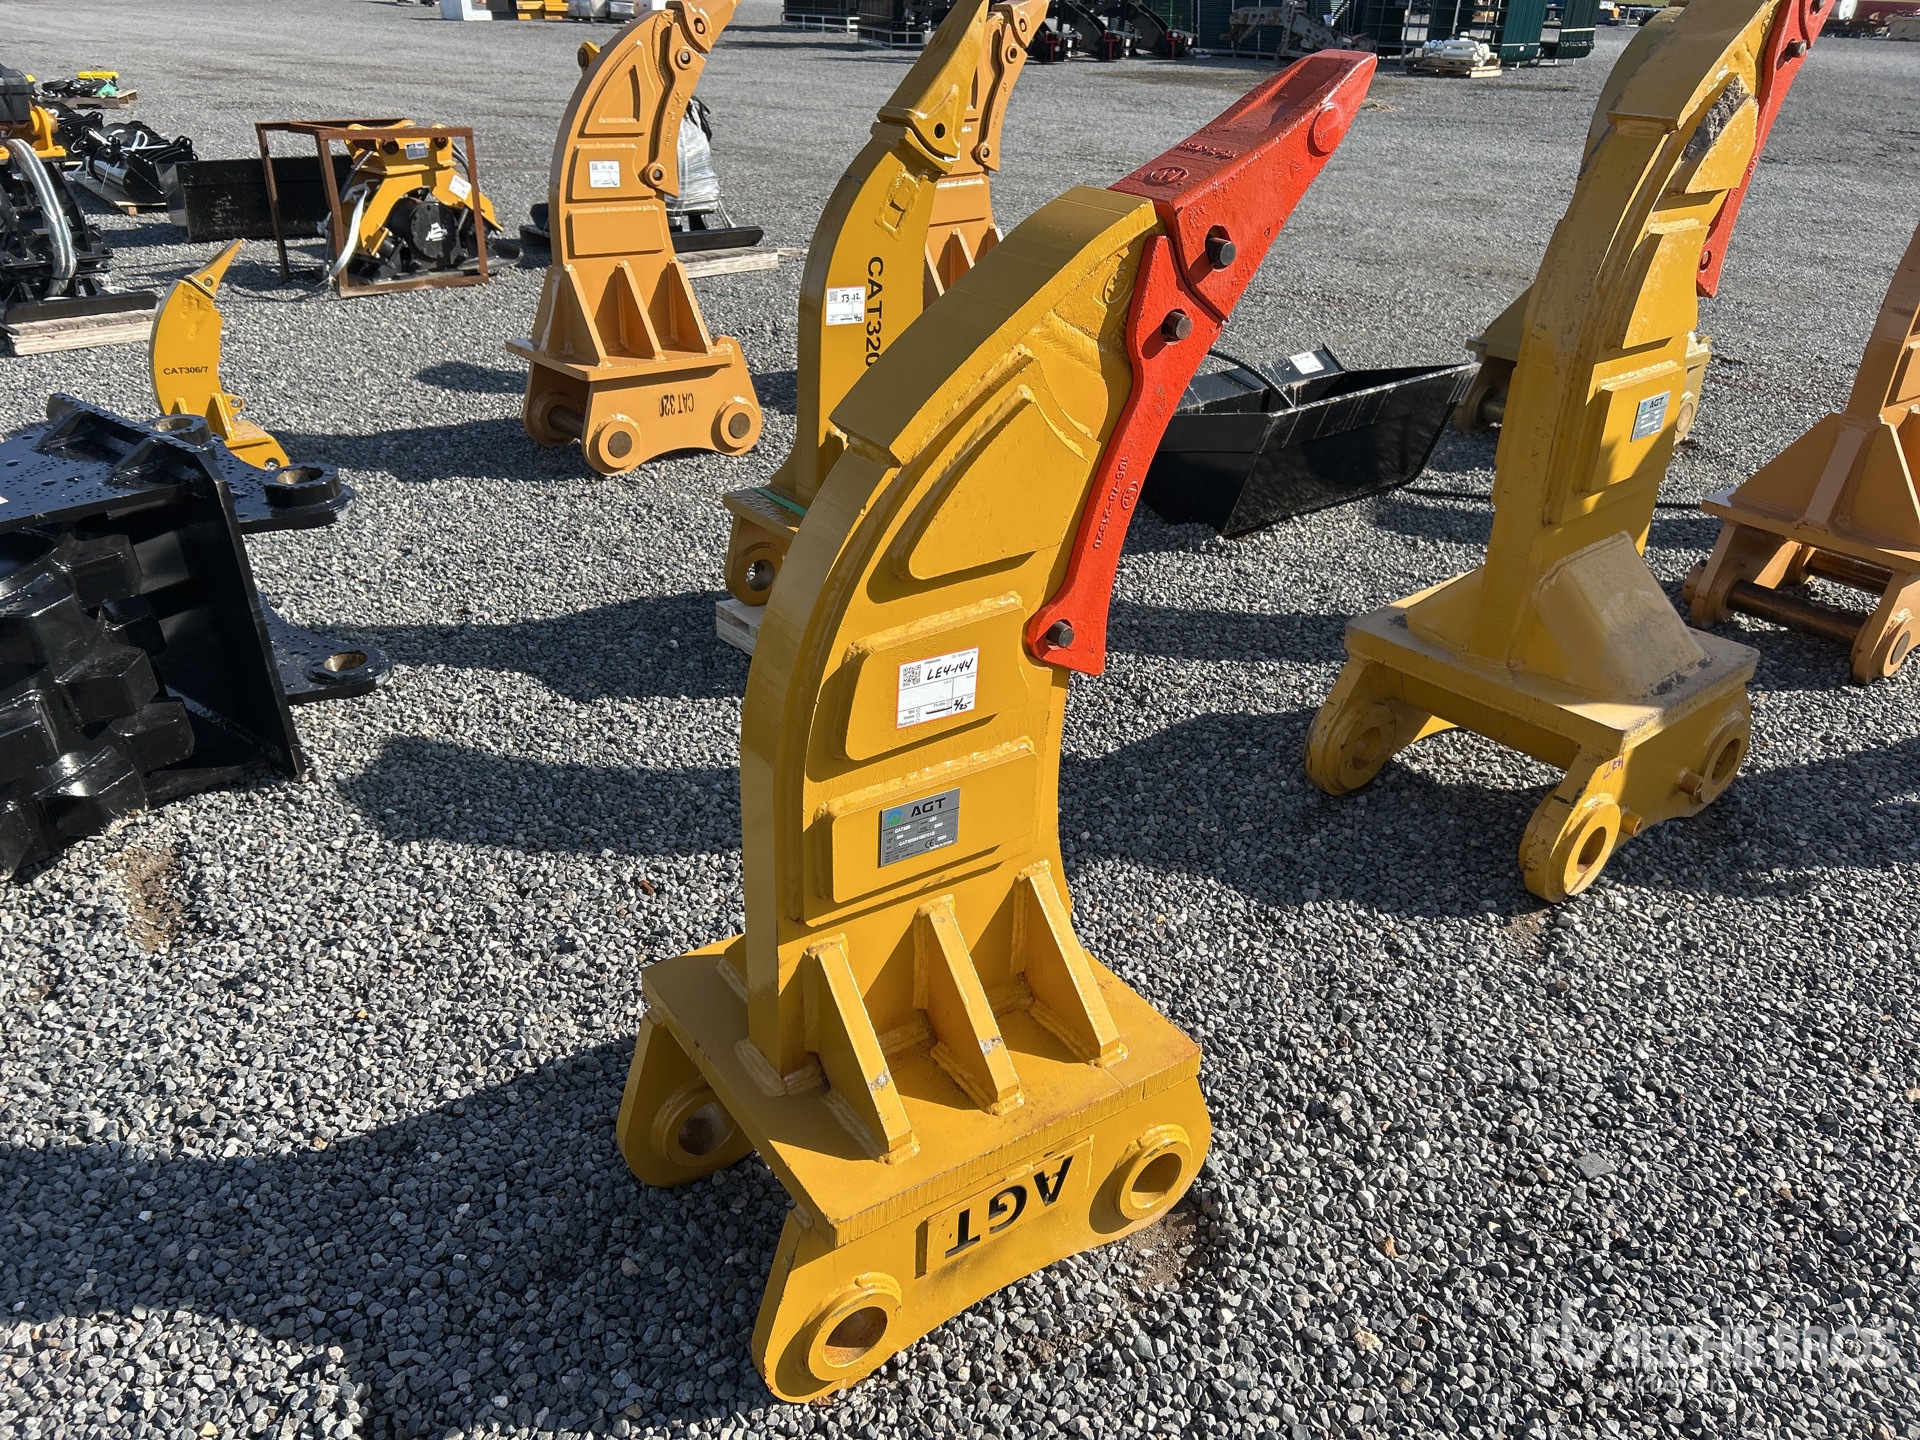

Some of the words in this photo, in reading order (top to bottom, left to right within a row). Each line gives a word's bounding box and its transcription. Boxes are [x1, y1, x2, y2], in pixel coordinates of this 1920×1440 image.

[163, 366, 209, 376] CAT306/7
[677, 392, 695, 414] CAT
[1649, 396, 1665, 409] AGT
[926, 657, 974, 681] LE4-144
[910, 797, 946, 818] AGT
[945, 1154, 1075, 1260] AGT
